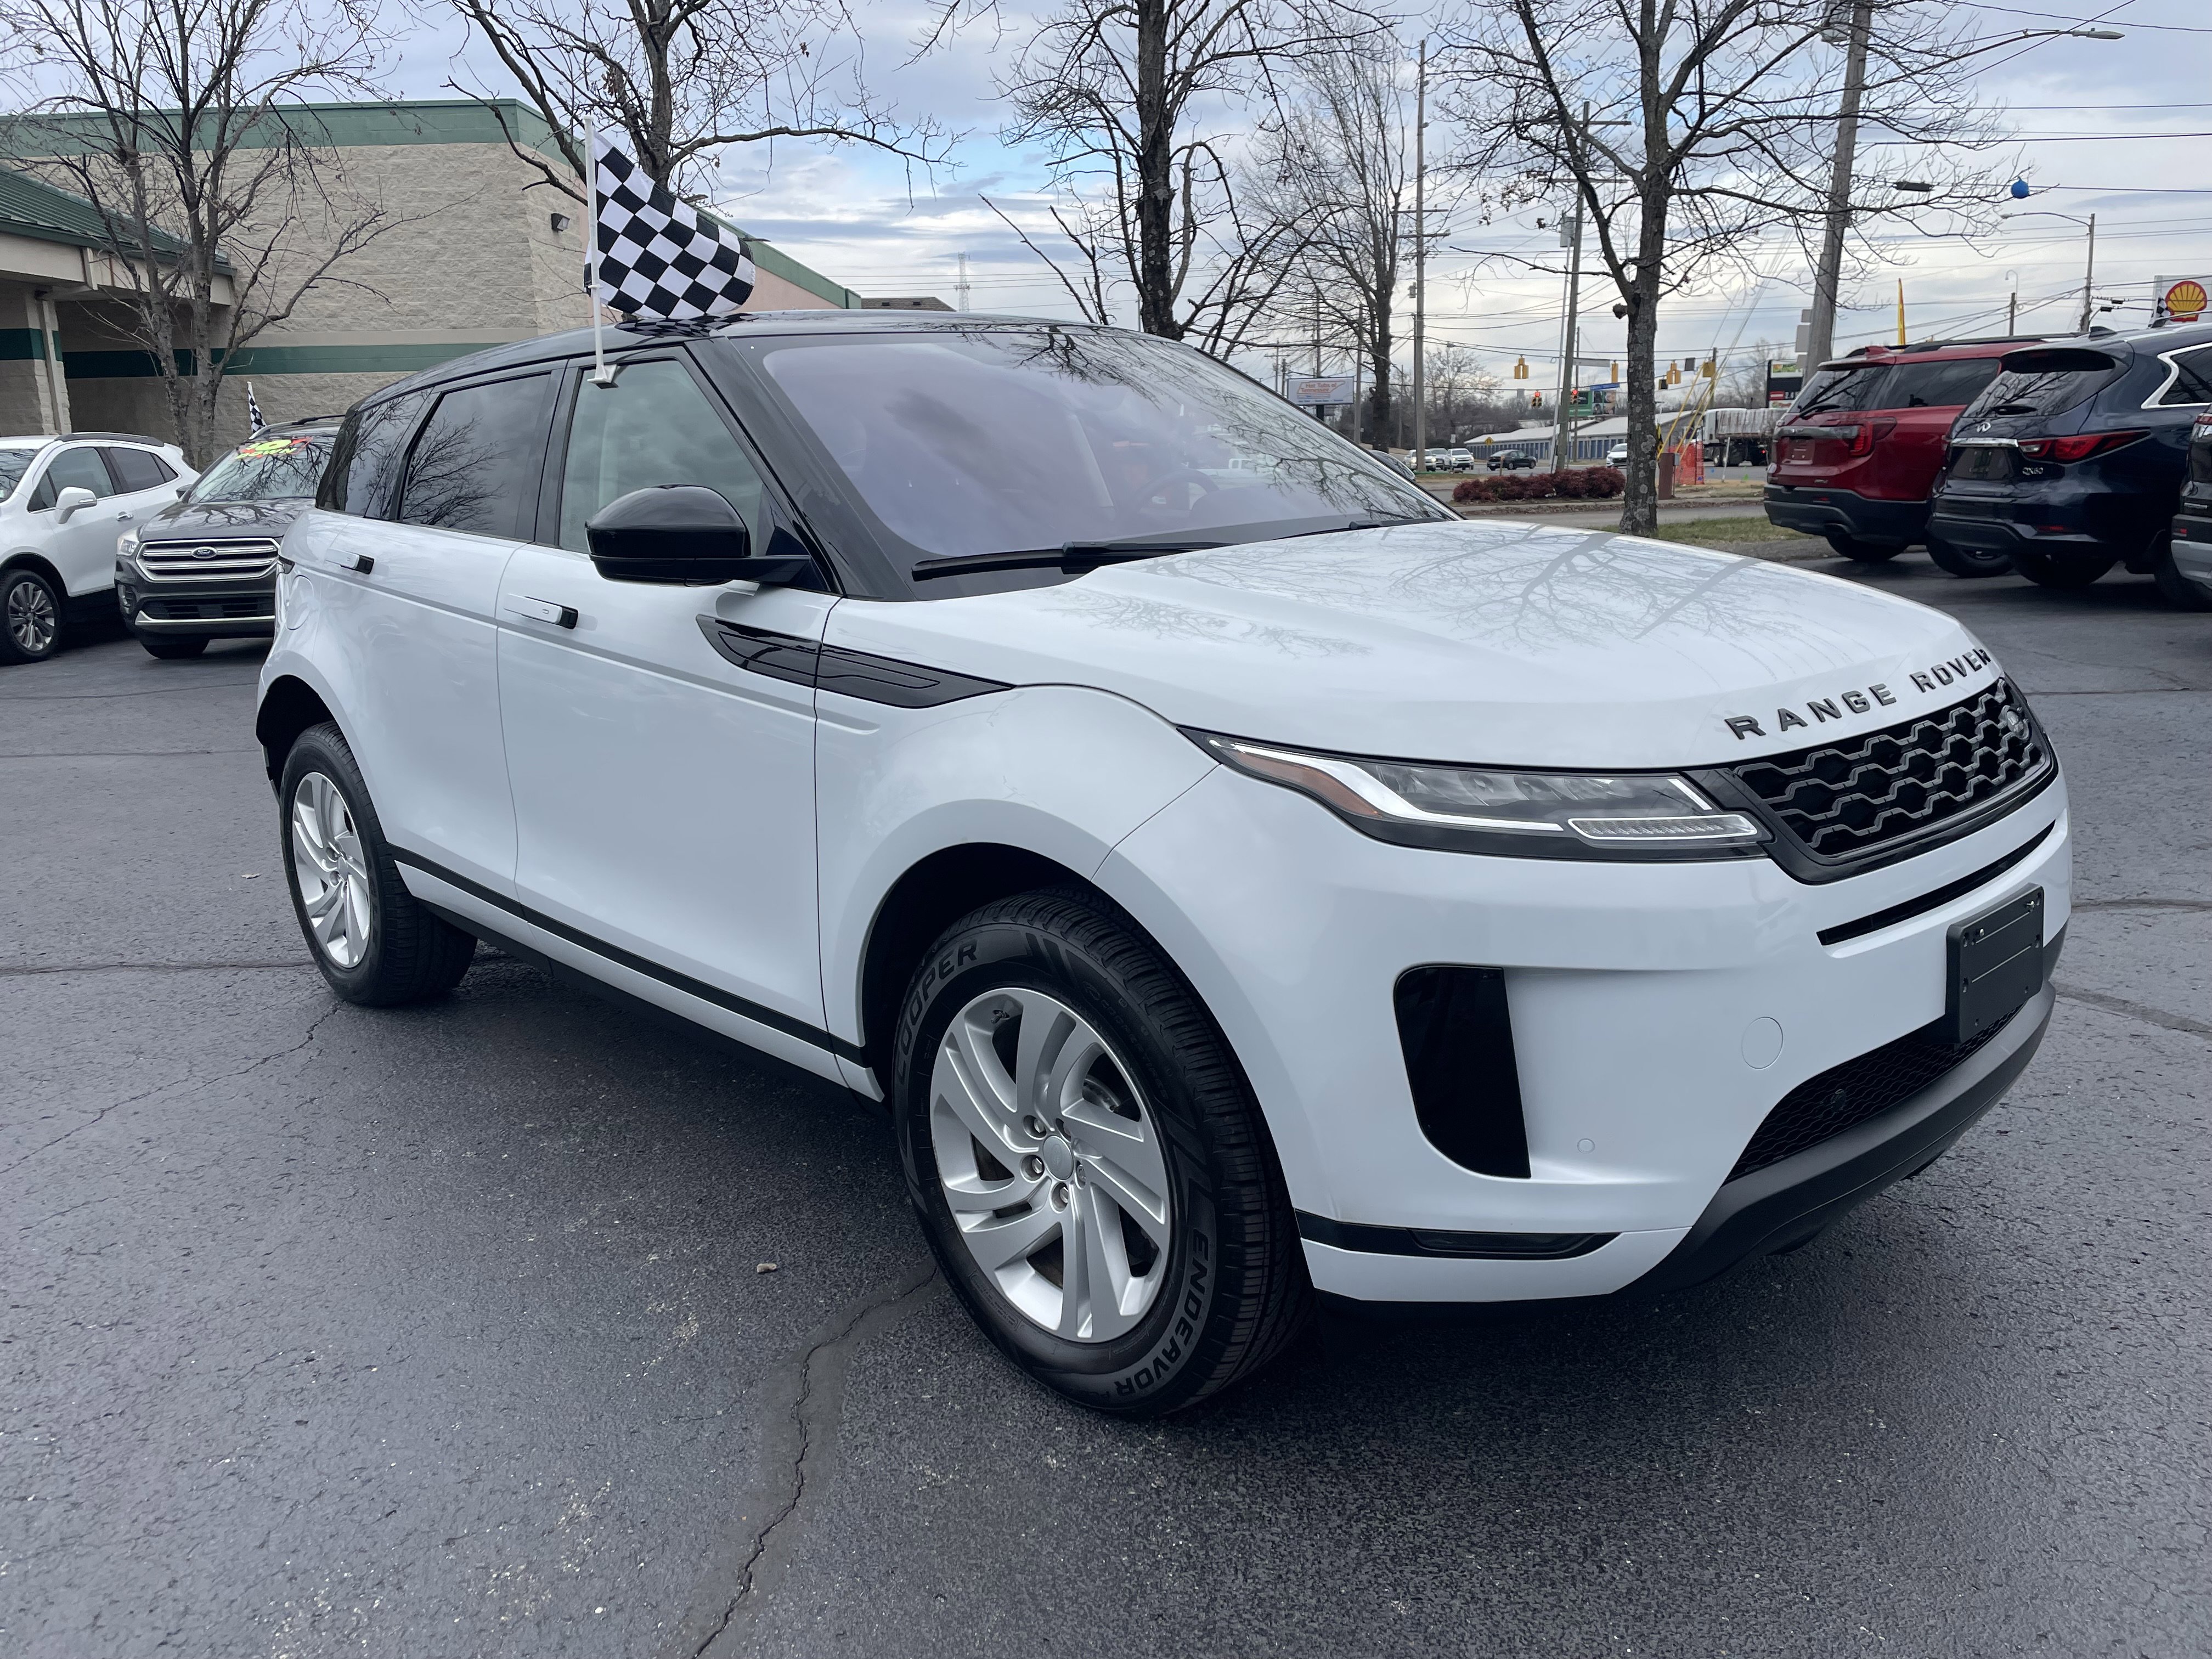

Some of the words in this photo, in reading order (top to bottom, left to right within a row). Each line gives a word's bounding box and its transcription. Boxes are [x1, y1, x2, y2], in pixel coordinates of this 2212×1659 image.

[235, 448, 297, 459] DOWN
[1724, 683, 1897, 740] RANGE
[1909, 648, 1991, 693] ROVER
[896, 938, 978, 1086] COOPER
[1114, 1228, 1209, 1396] ENDEAVOR
